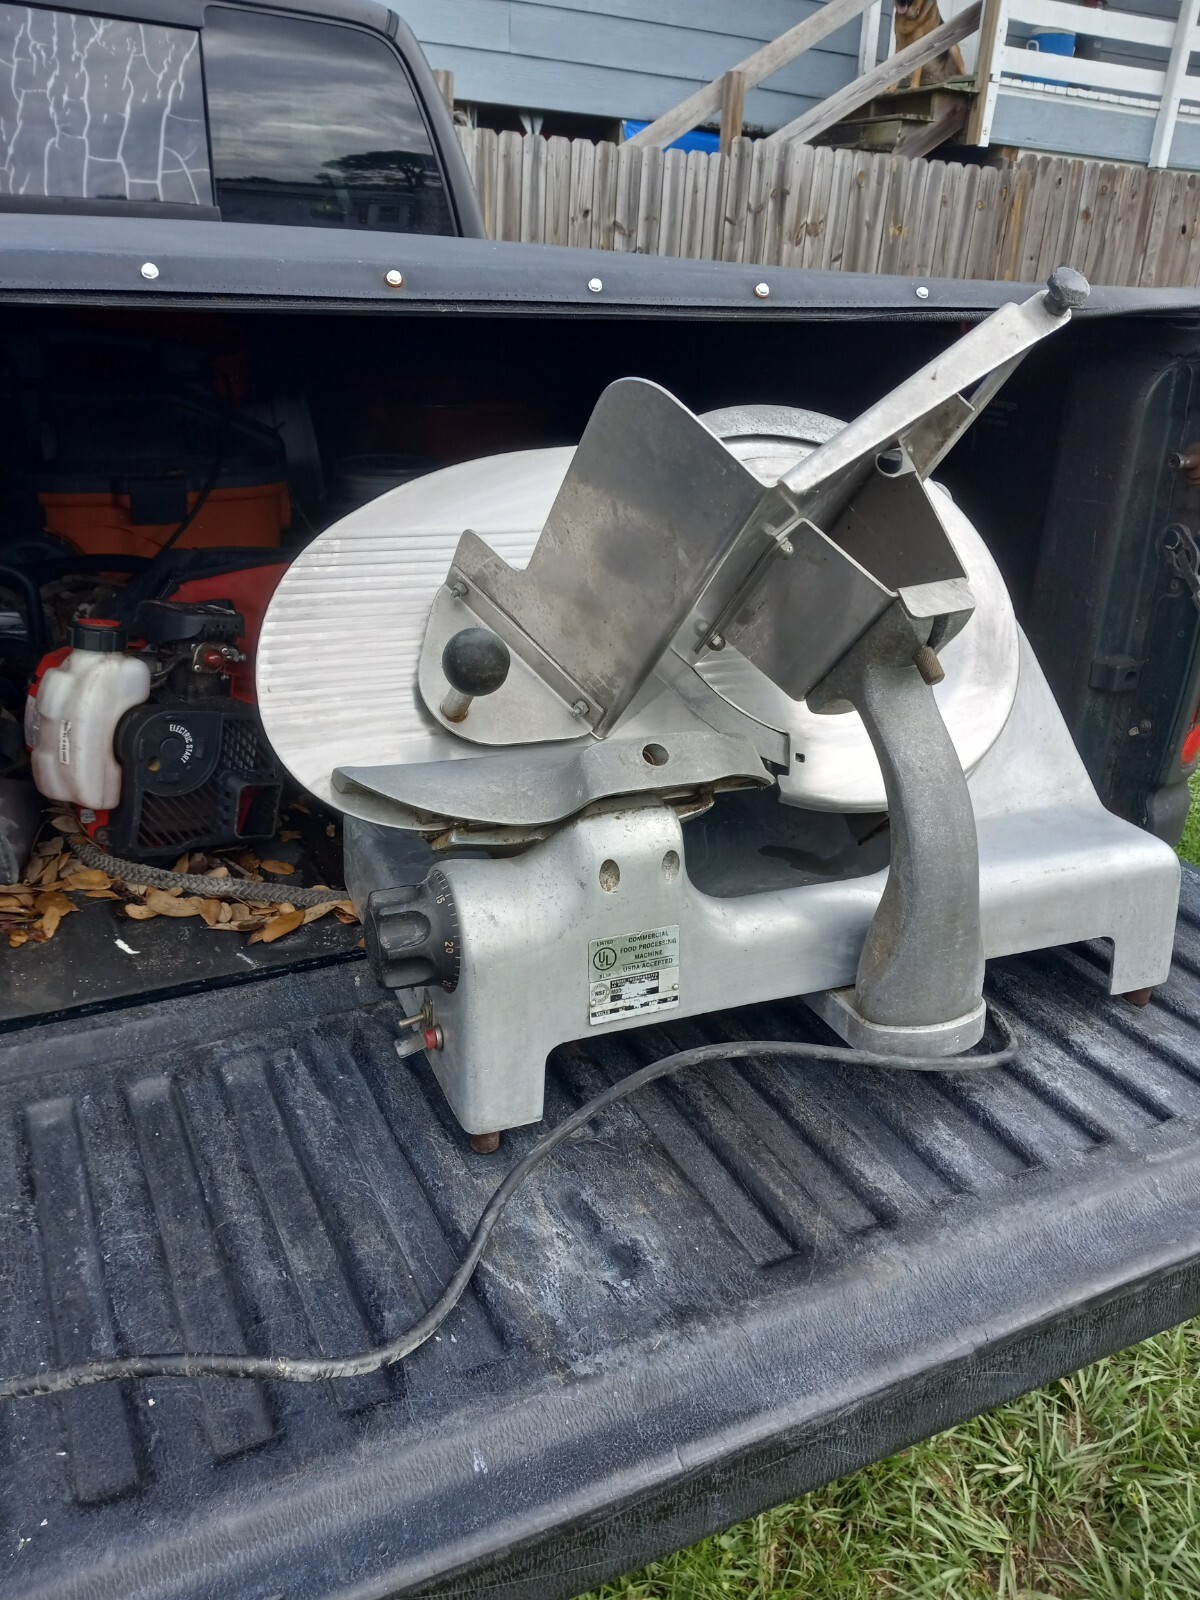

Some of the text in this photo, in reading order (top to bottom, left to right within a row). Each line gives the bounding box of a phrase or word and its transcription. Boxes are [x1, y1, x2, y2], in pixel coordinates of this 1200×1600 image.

[170, 724, 193, 764] ELECTRIC START
[436, 894, 445, 904] 15
[628, 931, 669, 943] COMMERCIAL
[444, 941, 454, 954] 20
[620, 946, 637, 954] FOOD
[598, 951, 612, 966] UL
[634, 949, 663, 960] MACHINE
[623, 958, 673, 973] USDA ACCEPTED
[596, 1009, 611, 1017] VOLTS
